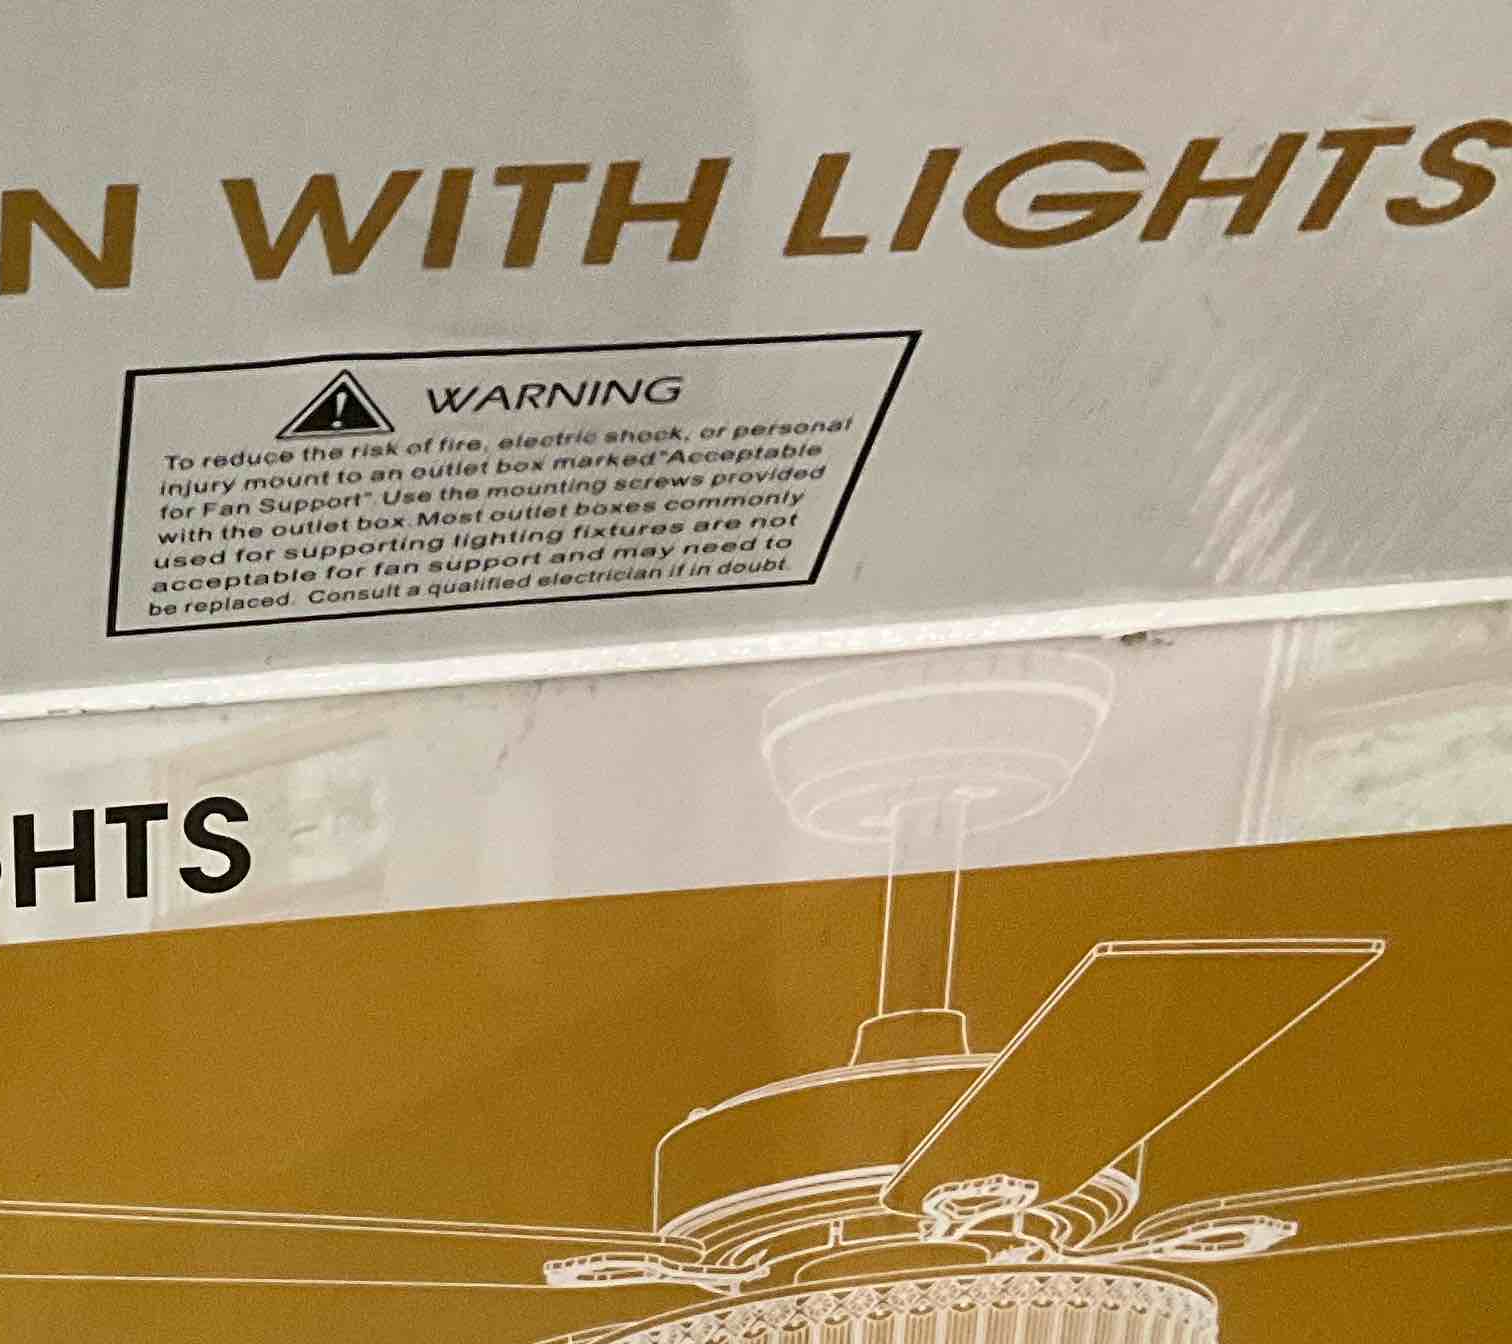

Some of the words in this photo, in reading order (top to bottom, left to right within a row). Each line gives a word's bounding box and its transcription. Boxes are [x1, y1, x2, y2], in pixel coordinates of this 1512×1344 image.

[220, 157, 732, 282] WITH
[781, 118, 1512, 258] LIGHTS
[426, 375, 683, 414] WARNING
[164, 454, 194, 471] To
[202, 449, 294, 469] reduce
[303, 442, 343, 461] the
[351, 440, 397, 458] risk
[406, 437, 433, 454] of
[439, 435, 488, 454] fire,
[498, 429, 599, 450] electric
[700, 425, 727, 440] or
[732, 415, 854, 440] personal
[160, 479, 236, 499] injury
[244, 470, 330, 492] mount
[338, 469, 363, 485] to
[370, 467, 403, 482] an
[411, 459, 488, 480] outlet
[496, 458, 545, 474] box
[160, 504, 193, 521] for
[203, 501, 251, 517] Fan
[383, 489, 432, 506] Use
[441, 485, 480, 502] the
[488, 478, 607, 500] mounting
[614, 472, 705, 490] screws
[711, 464, 827, 488] provided
[154, 550, 226, 570] used
[235, 546, 276, 564] for
[284, 535, 445, 562] supporting
[453, 527, 564, 552] lighting
[572, 520, 685, 541] fixtures
[694, 516, 742, 533] are
[750, 512, 799, 529] not
[157, 526, 213, 545] with
[222, 522, 263, 540] the
[272, 517, 349, 537] outlet
[490, 504, 569, 523] outlet
[575, 499, 657, 516] boxes
[664, 490, 805, 513] commonly
[148, 601, 177, 617] be
[308, 583, 401, 605] Consult
[407, 585, 420, 598] a
[427, 572, 531, 598] qualified
[538, 564, 663, 588] electrician
[668, 562, 687, 580] if
[689, 562, 712, 577] in
[151, 566, 317, 594] acceptable
[325, 563, 367, 581] for
[374, 560, 419, 577] fan
[428, 551, 542, 574] support
[549, 546, 606, 566] and
[613, 542, 676, 560] may
[683, 538, 756, 556] need
[766, 535, 793, 551] to
